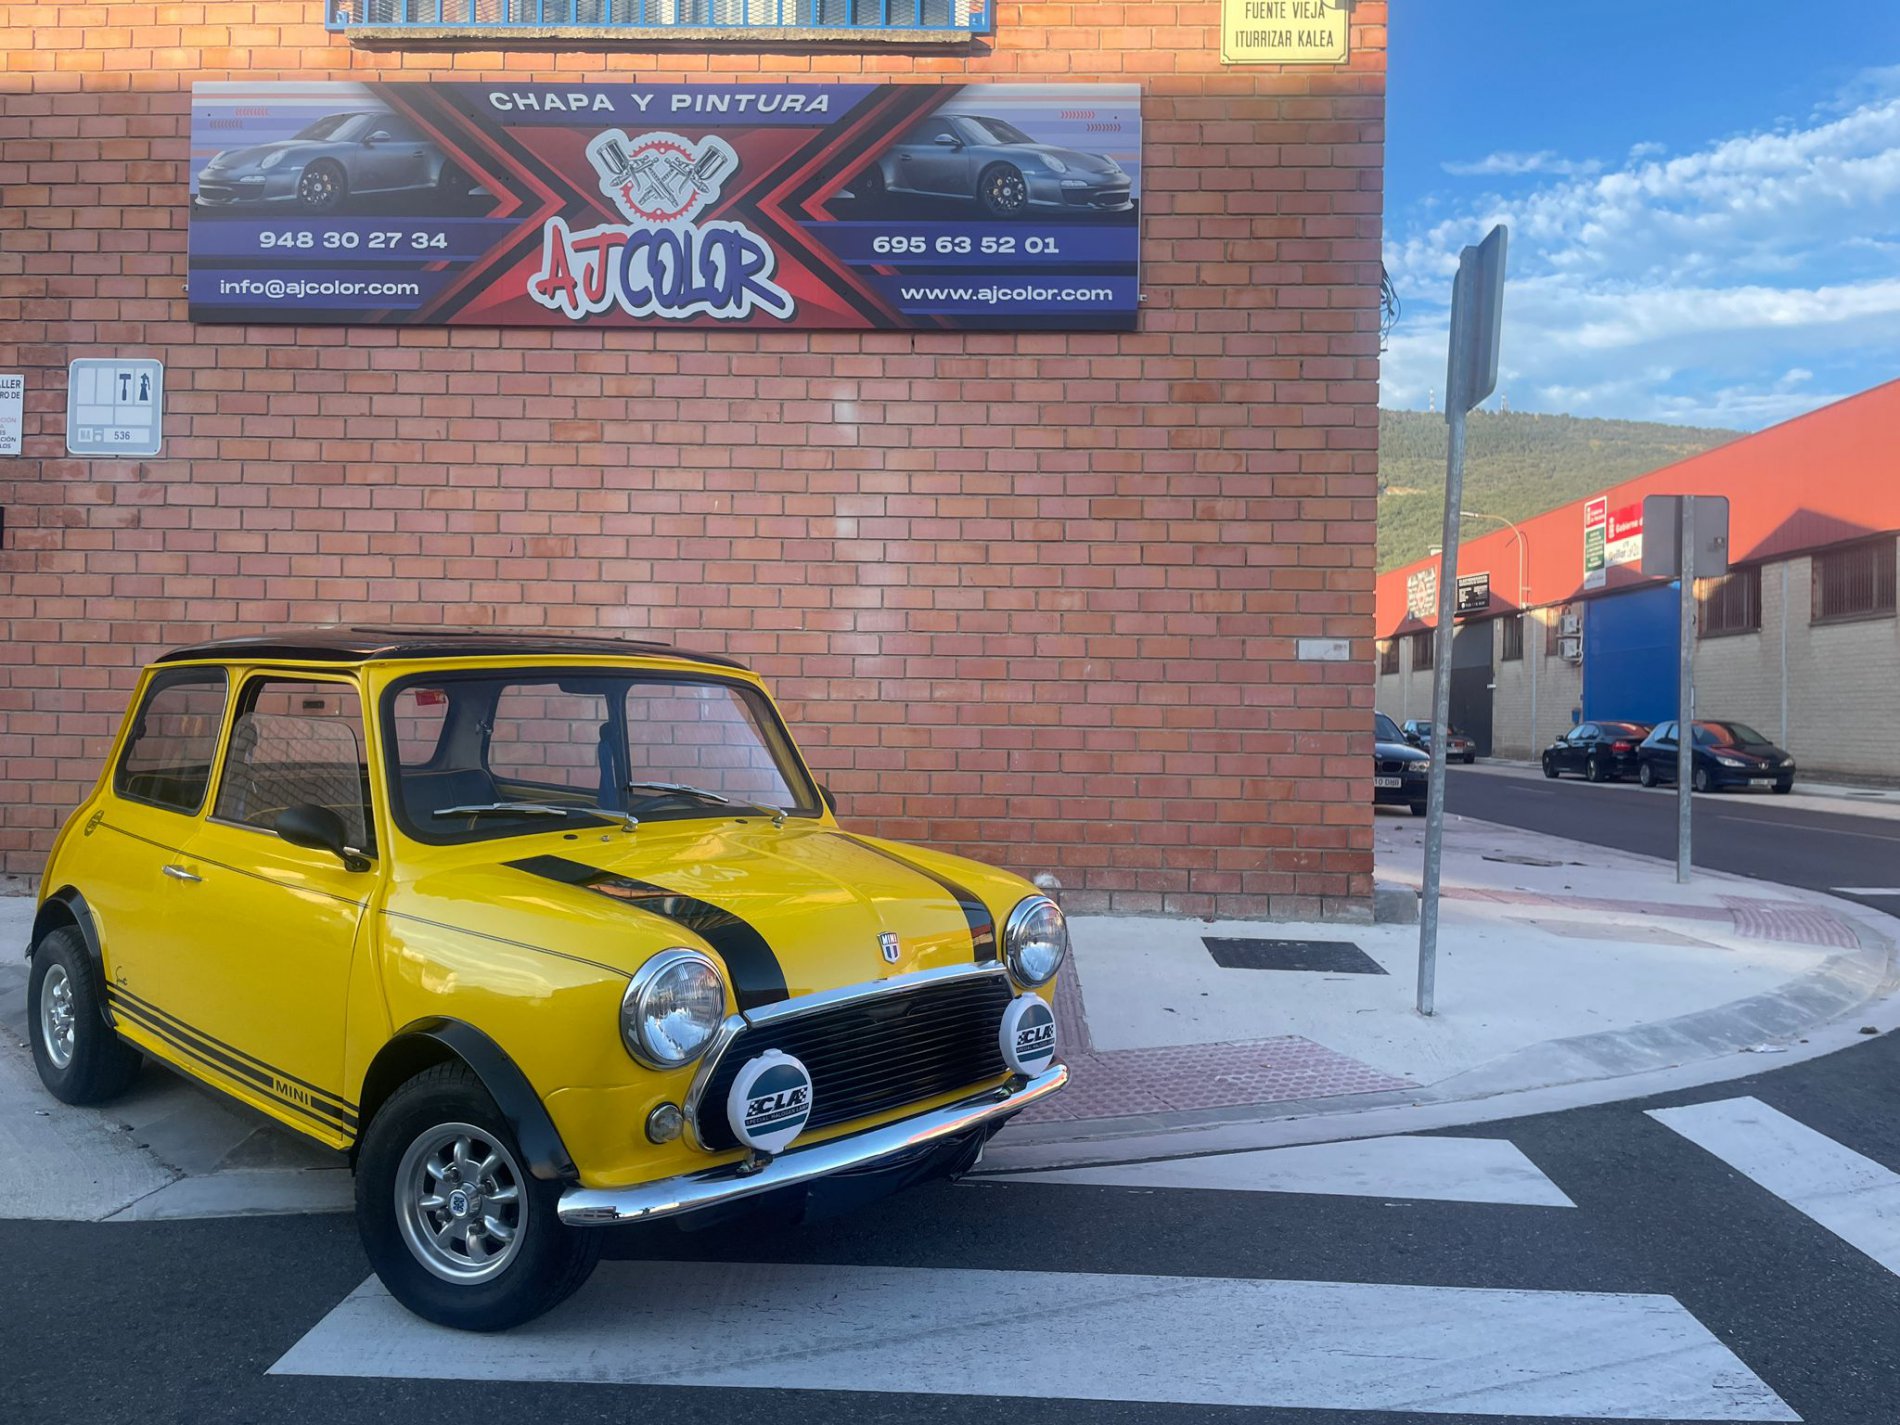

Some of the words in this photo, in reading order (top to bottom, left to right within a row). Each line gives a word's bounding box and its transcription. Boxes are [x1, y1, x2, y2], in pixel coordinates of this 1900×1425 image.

[1245, 1, 1286, 19] FUENTE
[1293, 1, 1325, 19] VIEJA
[1235, 29, 1292, 48] ITURRIZAR
[1298, 29, 1334, 48] KALEA
[488, 92, 615, 112] CHAPA
[631, 93, 655, 112] Y
[671, 93, 829, 113] PINTURA
[259, 231, 314, 249] 948
[323, 231, 360, 249] 30
[368, 232, 402, 249] 27
[411, 232, 448, 249] 34
[872, 236, 927, 254] 695
[935, 236, 972, 254] 63
[980, 236, 1016, 254] 52
[1024, 236, 1060, 254] 01
[219, 279, 419, 299] info@ajcolor.com
[900, 285, 1113, 305] www.ajcolor.com
[0, 379, 21, 389] LLER
[11, 391, 20, 399] DE
[114, 431, 131, 440] 536
[881, 933, 897, 945] MINI
[1023, 1025, 1053, 1043] CLA
[276, 1079, 308, 1105] MINI
[754, 1088, 806, 1114] CLA
[746, 1115, 770, 1125] SPECIAL
